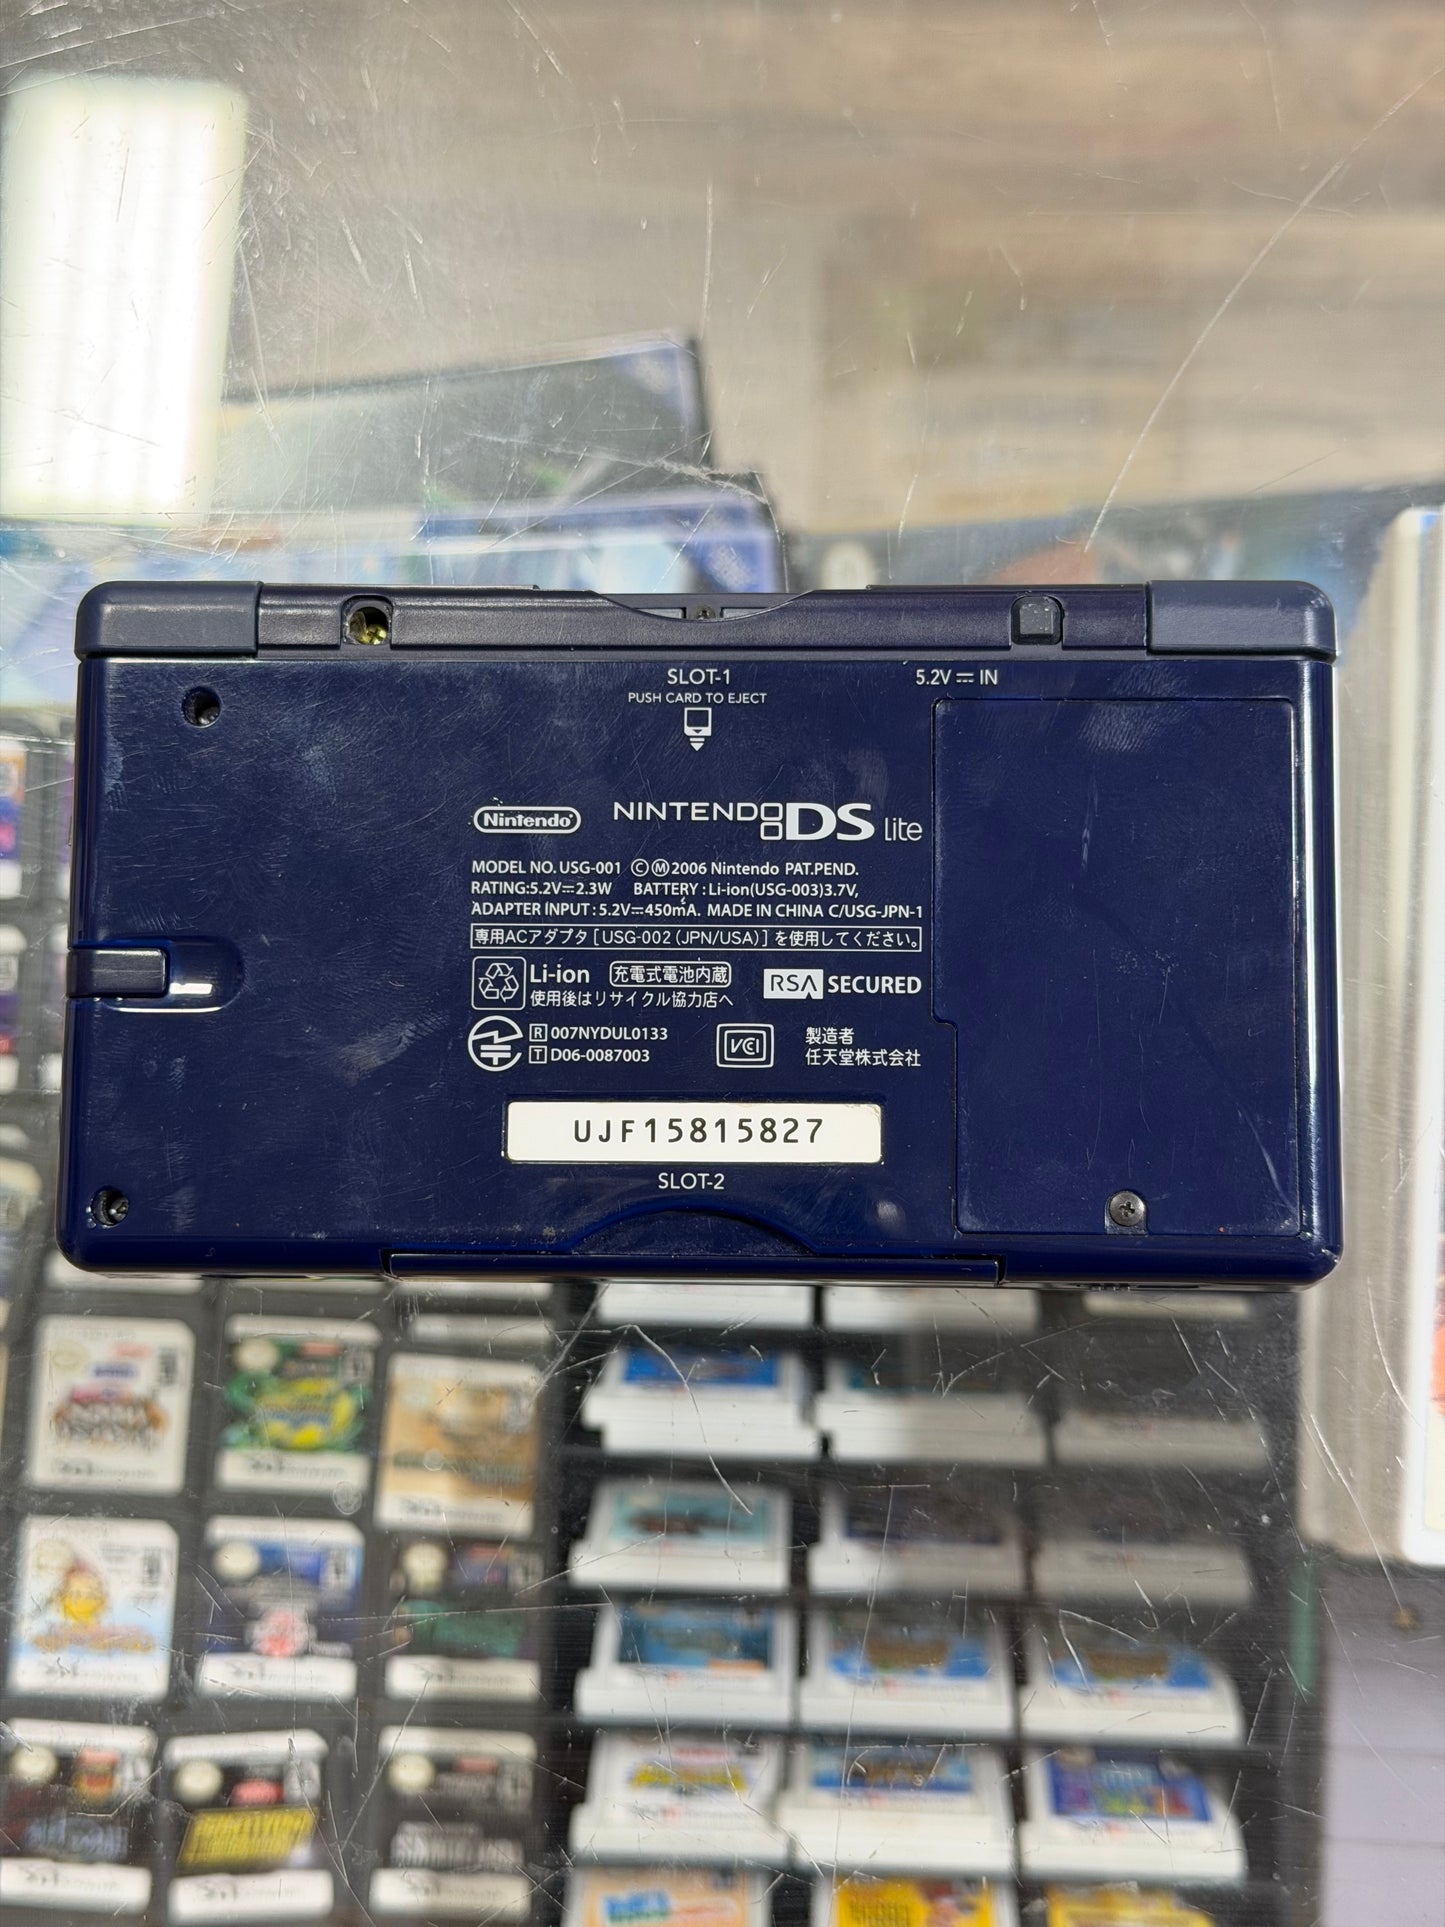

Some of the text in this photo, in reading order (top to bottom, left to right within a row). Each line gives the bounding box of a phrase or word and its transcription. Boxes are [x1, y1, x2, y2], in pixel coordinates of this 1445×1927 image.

[668, 668, 729, 684] SLOT-1
[916, 669, 997, 685] 5.2V IN
[629, 693, 767, 703] PUSH CARD TO EJECT
[484, 812, 574, 827] Nintendo
[786, 803, 875, 840] DS
[885, 818, 922, 841] lite
[472, 860, 526, 873] MODEL
[531, 861, 556, 873] NO.
[560, 861, 620, 874] USG-001
[711, 862, 779, 875] Nintendo
[786, 863, 858, 875] PAT.PEND.
[472, 901, 540, 915] ADAPTER
[708, 904, 752, 916] MADE
[757, 904, 771, 917] IN
[776, 904, 823, 917] CHINA
[829, 905, 921, 918] C/USG-JPN-1
[531, 964, 589, 983] Li-ion
[614, 965, 729, 984] 充電式電池内蔵
[828, 976, 921, 993] SECURED
[531, 990, 733, 1007] 使用後はリサイクル協力店へ
[551, 1027, 667, 1040] 007NYDUL0133
[806, 1027, 854, 1044] 製造者
[551, 1048, 649, 1062] D06-0087003
[806, 1048, 920, 1066] 任天堂株式会社
[575, 1118, 822, 1143] UJF15815827
[659, 1173, 724, 1189] SLOT-2
